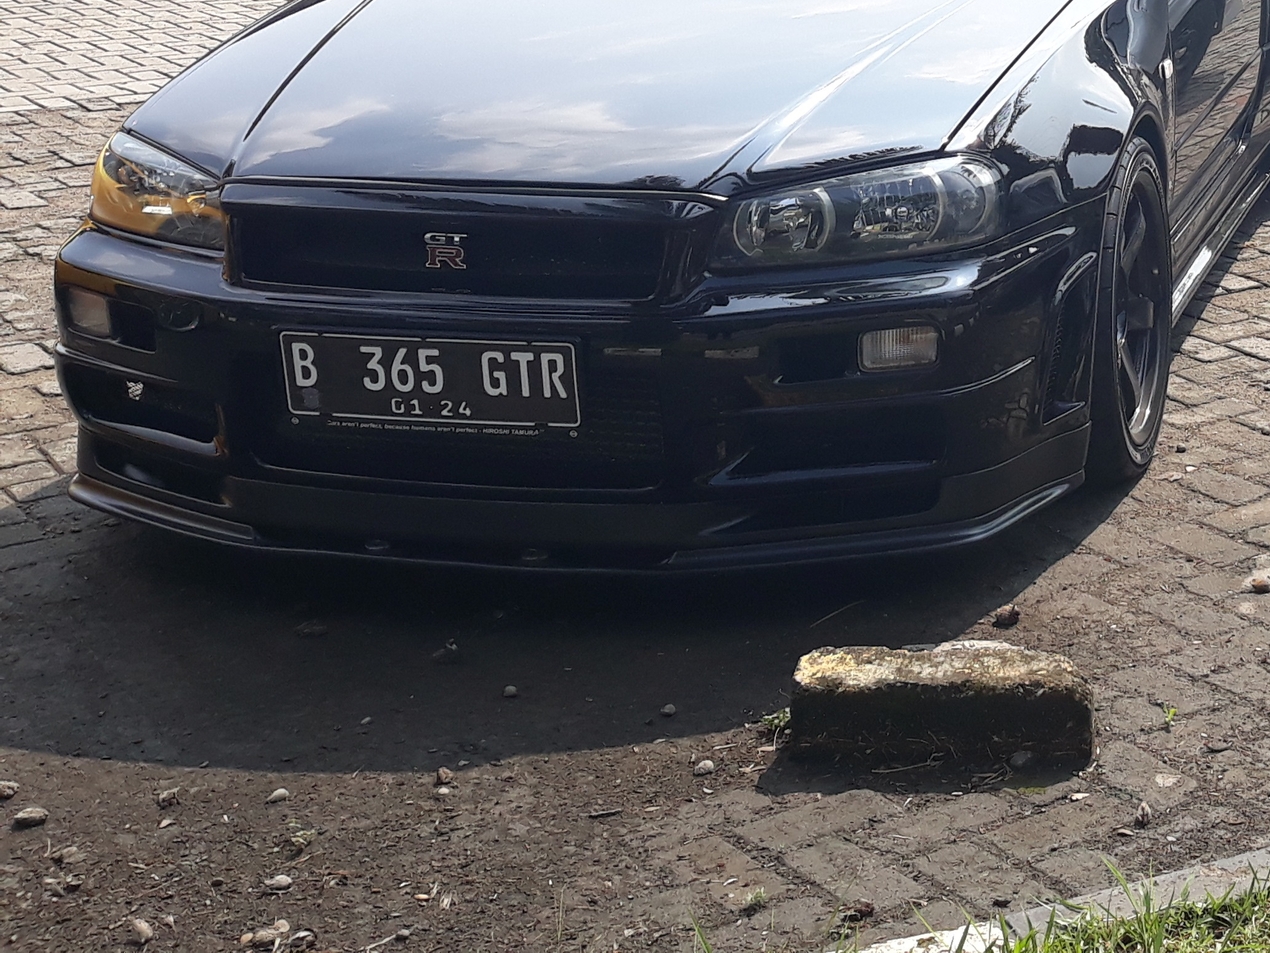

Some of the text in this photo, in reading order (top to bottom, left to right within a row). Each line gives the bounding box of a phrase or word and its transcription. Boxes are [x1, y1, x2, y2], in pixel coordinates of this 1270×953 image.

[424, 232, 468, 245] GT
[425, 245, 467, 269] R
[291, 342, 568, 398] B 365 GTR
